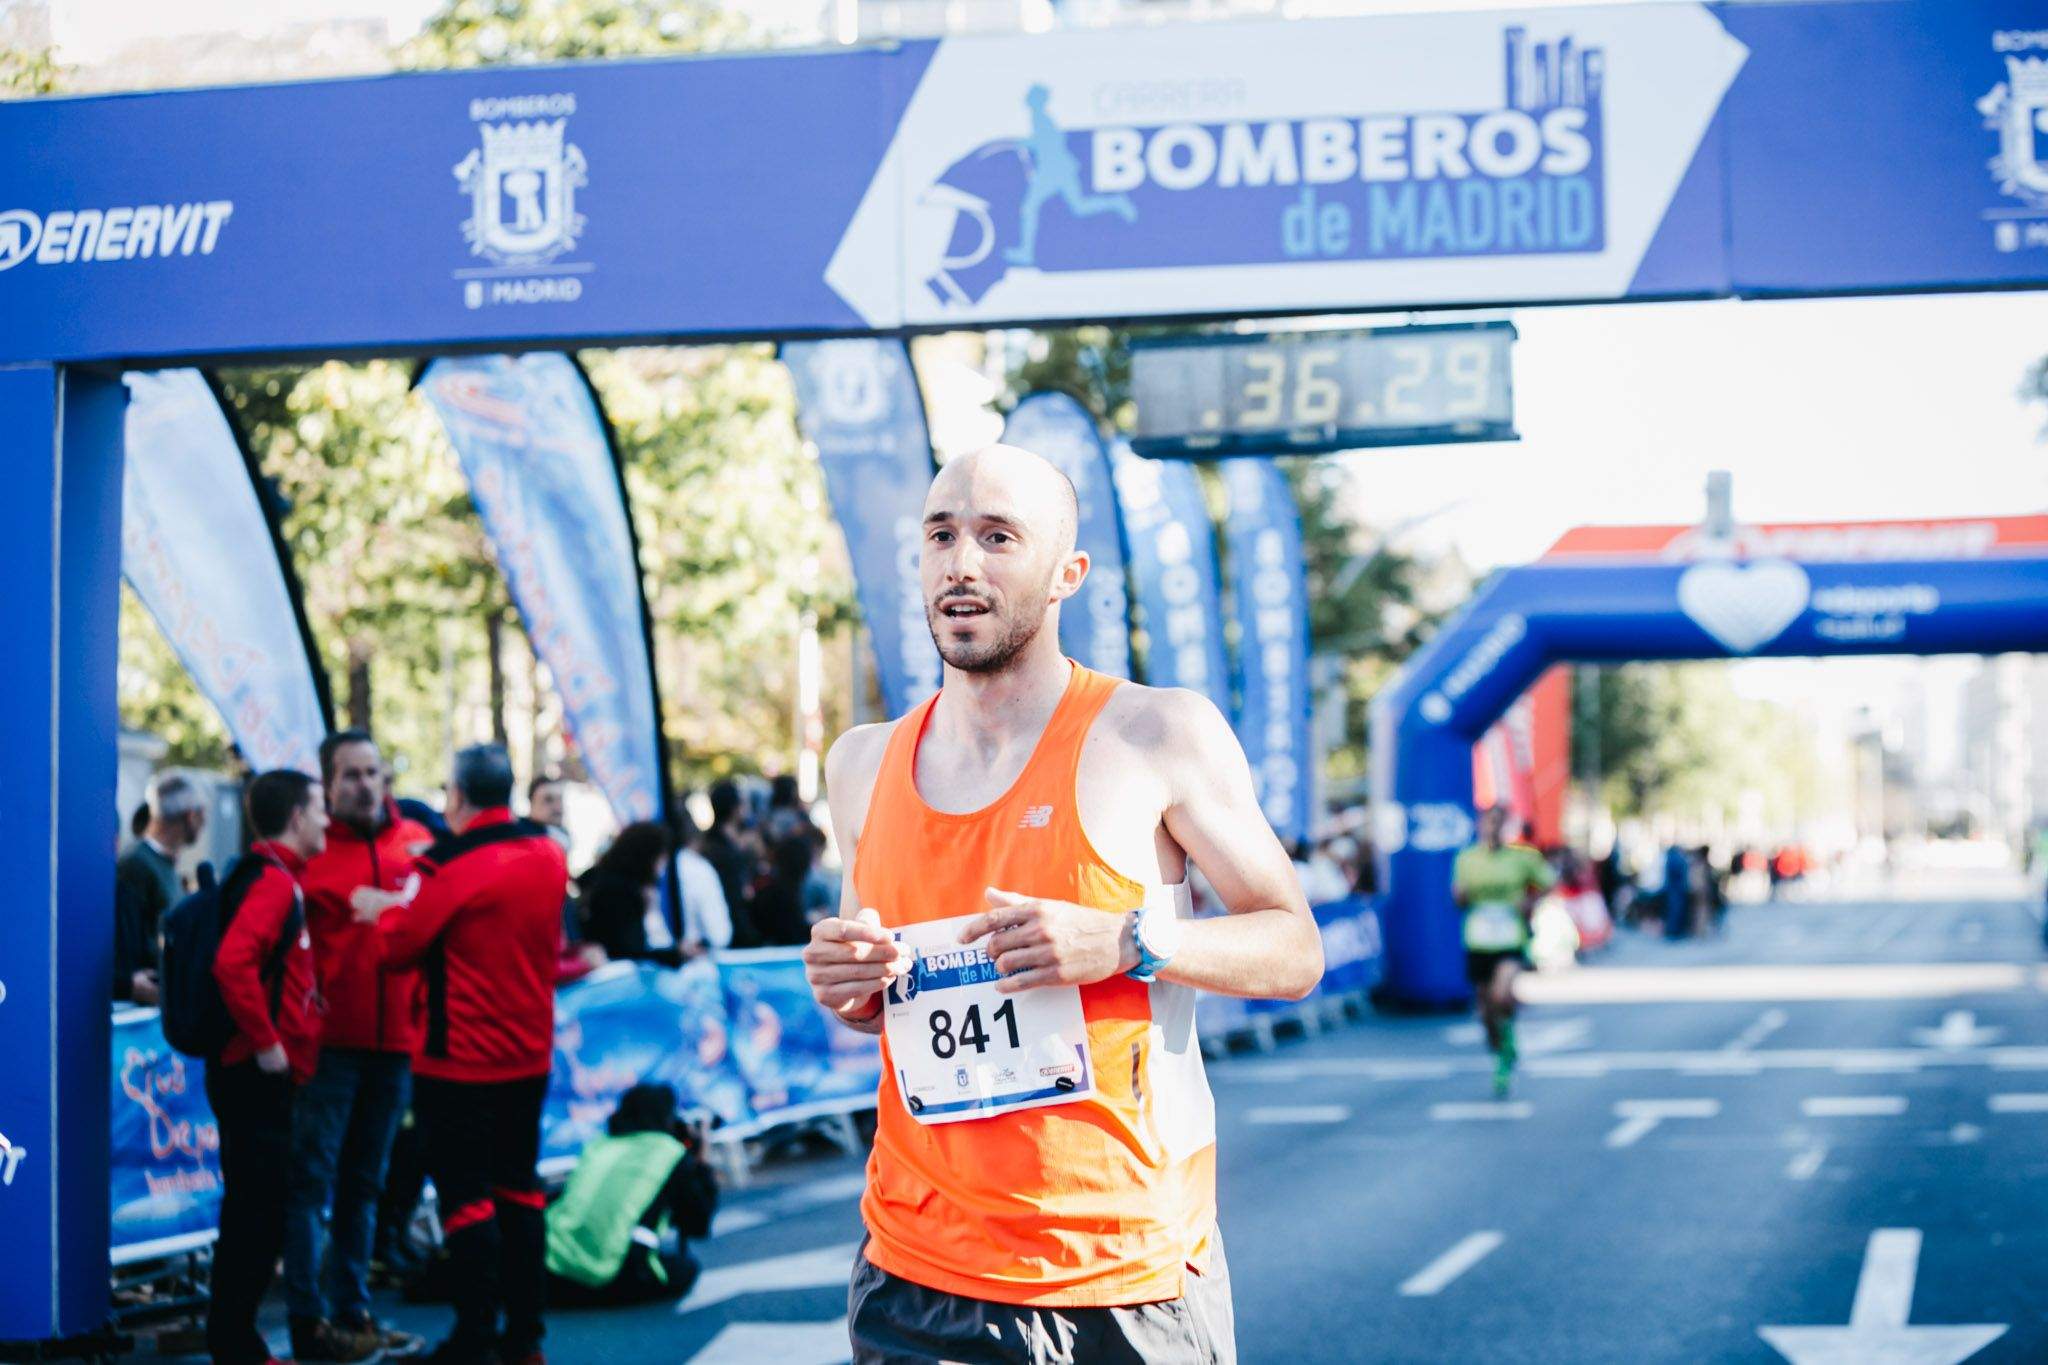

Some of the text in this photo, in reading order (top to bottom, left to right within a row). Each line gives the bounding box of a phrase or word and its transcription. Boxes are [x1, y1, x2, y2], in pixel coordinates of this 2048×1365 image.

[470, 92, 576, 121] BOMBEROS
[1091, 107, 1592, 193] BOMBEROS
[1282, 176, 1596, 256] de MADRID
[492, 278, 583, 304] MADRID
[928, 999, 1020, 1059] 841
